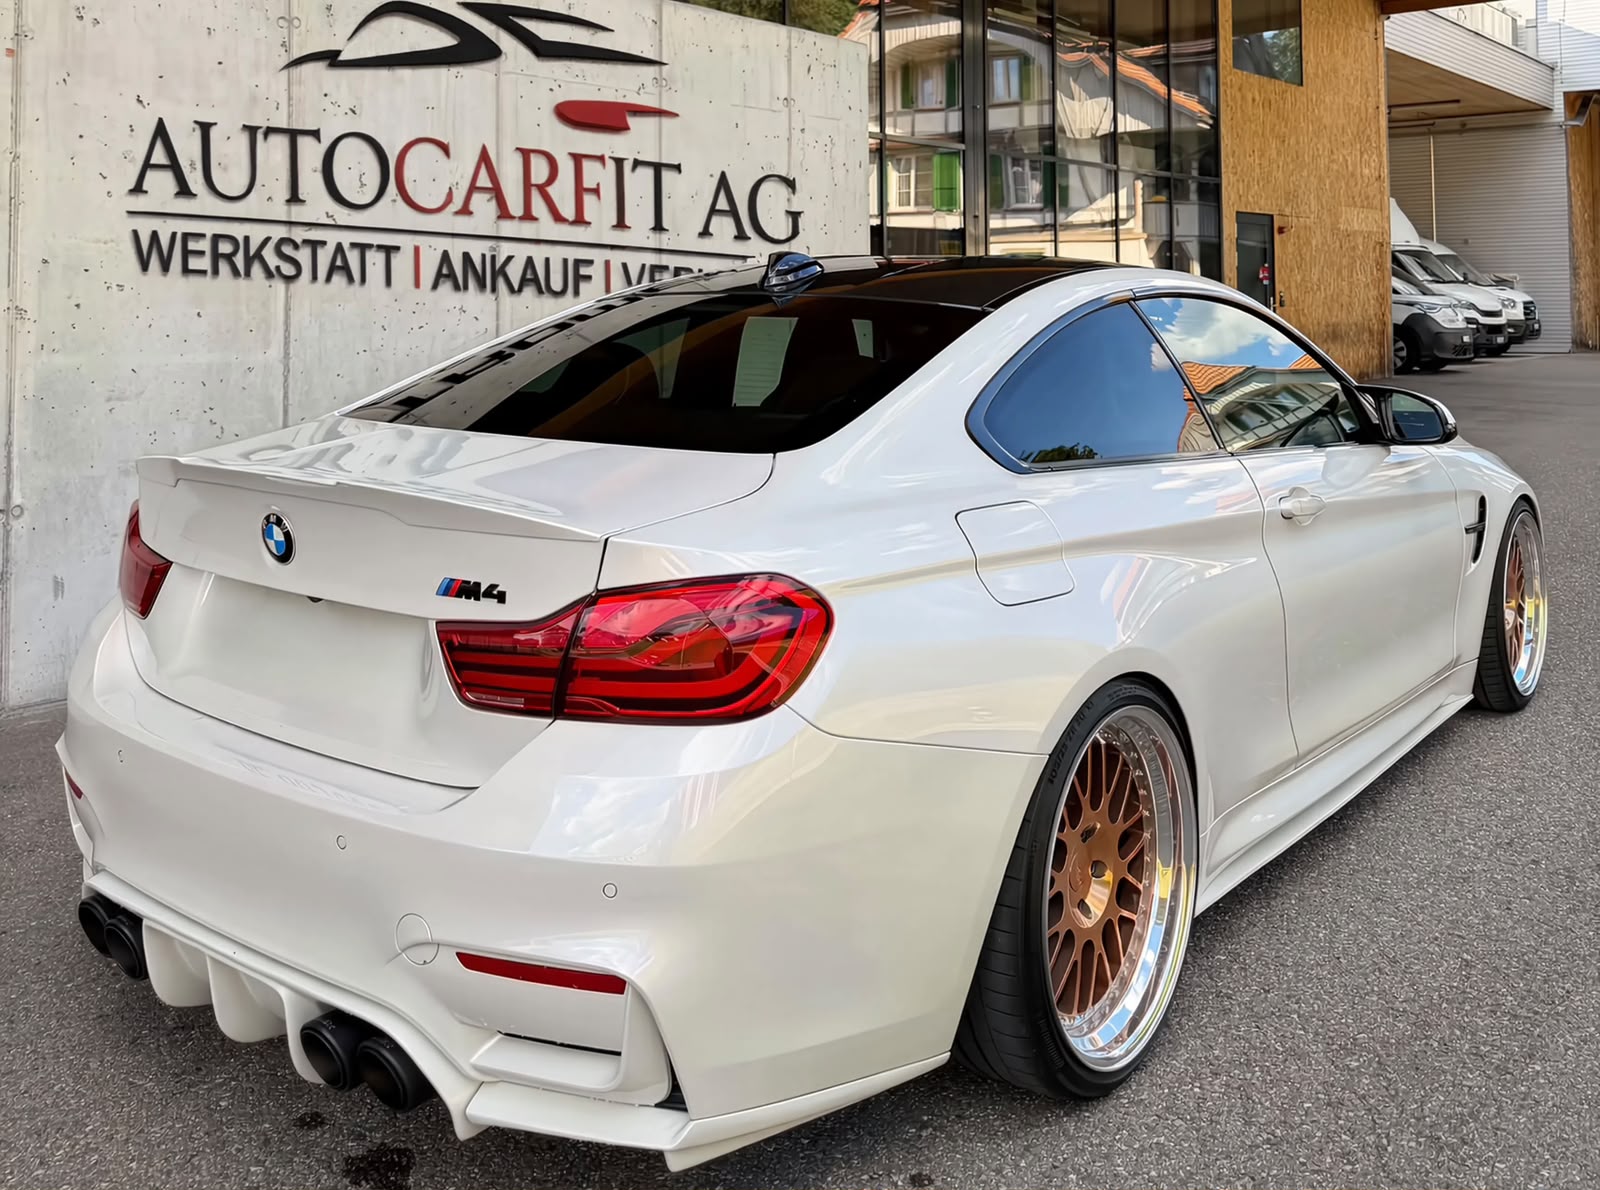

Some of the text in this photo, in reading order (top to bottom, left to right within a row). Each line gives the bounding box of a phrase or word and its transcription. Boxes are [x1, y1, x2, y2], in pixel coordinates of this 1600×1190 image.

[128, 117, 803, 244] AUTOCARFIT AG
[131, 229, 401, 288] WERKSTATT
[431, 249, 594, 297] ANKAUF
[456, 579, 507, 605] M4
